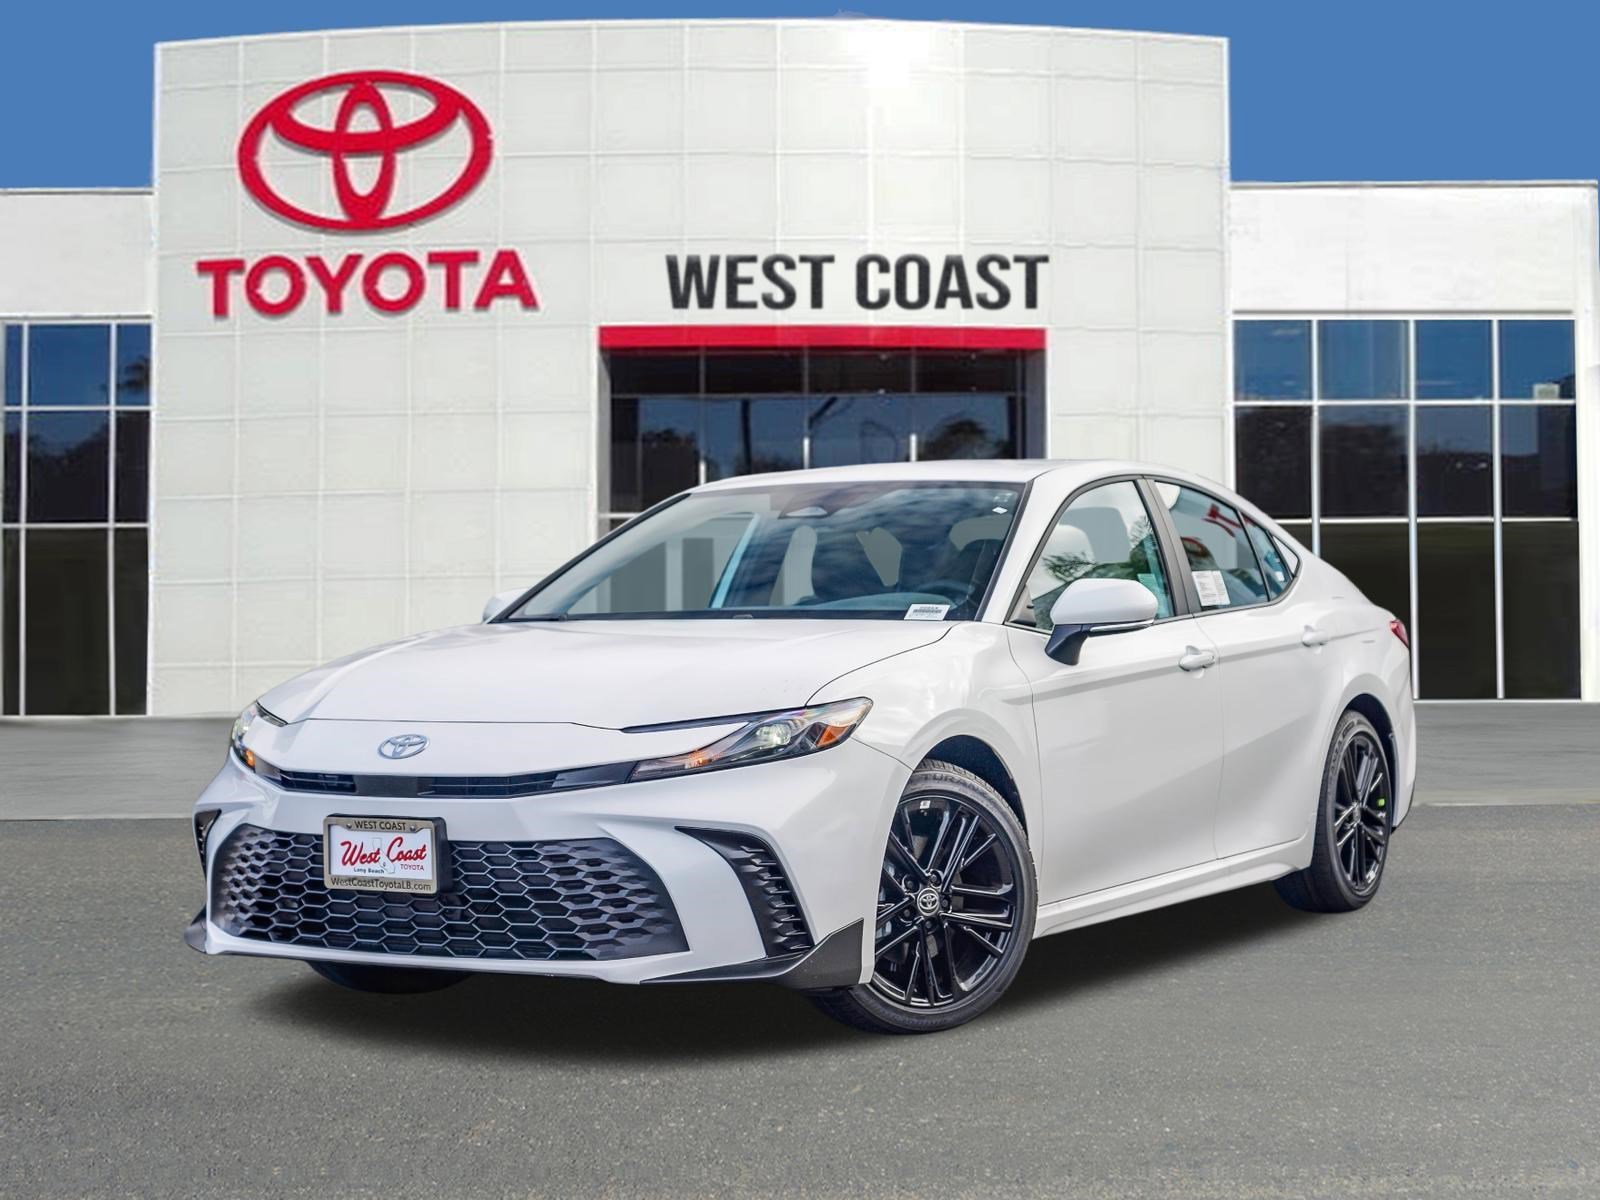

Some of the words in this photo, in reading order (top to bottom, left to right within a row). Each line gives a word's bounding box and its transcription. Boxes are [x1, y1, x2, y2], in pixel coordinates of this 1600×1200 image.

[197, 249, 539, 319] TOYOTA
[665, 254, 835, 310] WEST
[855, 253, 1049, 310] COAST
[355, 821, 377, 830] WEST
[379, 821, 406, 831] COAST
[340, 841, 381, 866] West
[387, 836, 427, 863] Coast
[400, 863, 425, 872] TOYOTA
[330, 877, 432, 892] WestCoastToyotaLB.com
